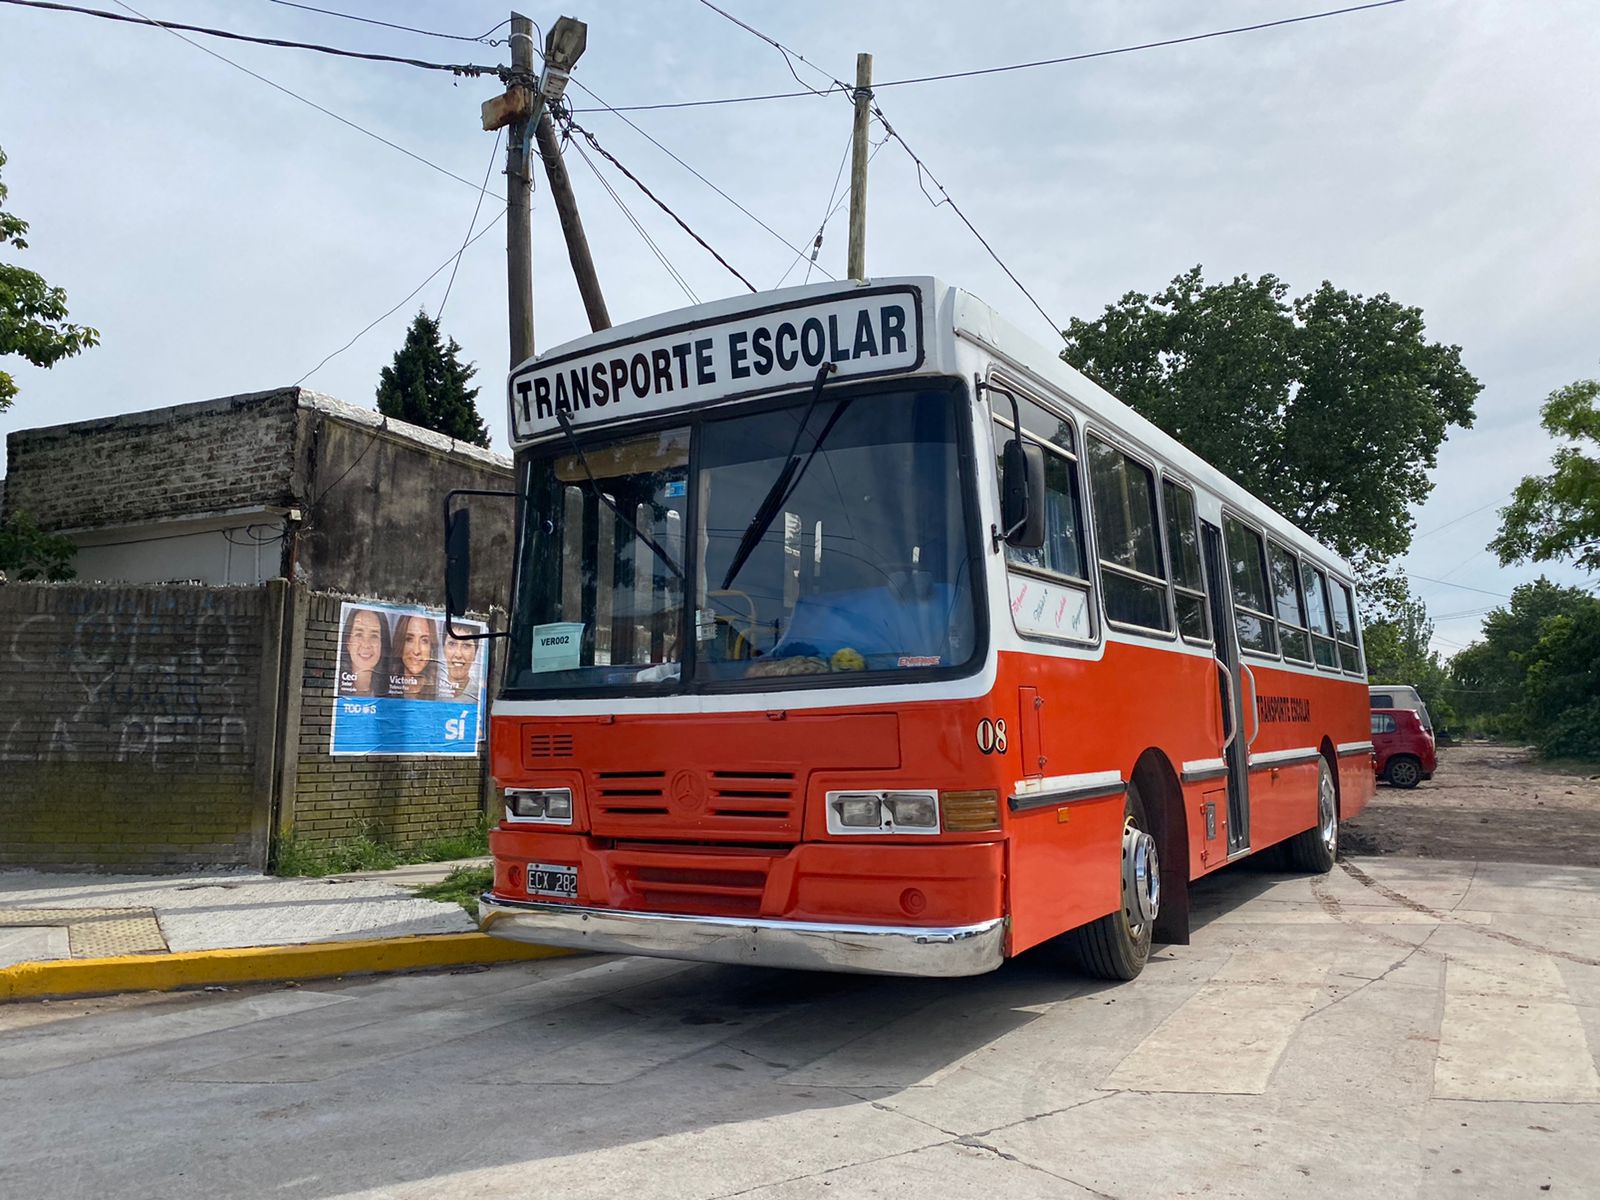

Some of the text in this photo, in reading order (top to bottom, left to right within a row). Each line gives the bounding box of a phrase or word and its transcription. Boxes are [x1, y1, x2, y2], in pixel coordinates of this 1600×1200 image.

[516, 305, 908, 422] TRANSPORTE ESCOLAR
[540, 635, 570, 647] VER002
[341, 672, 358, 681] Ceci
[389, 675, 418, 685] Victoria
[976, 717, 1008, 755] 08
[528, 871, 577, 892] ECX 282
